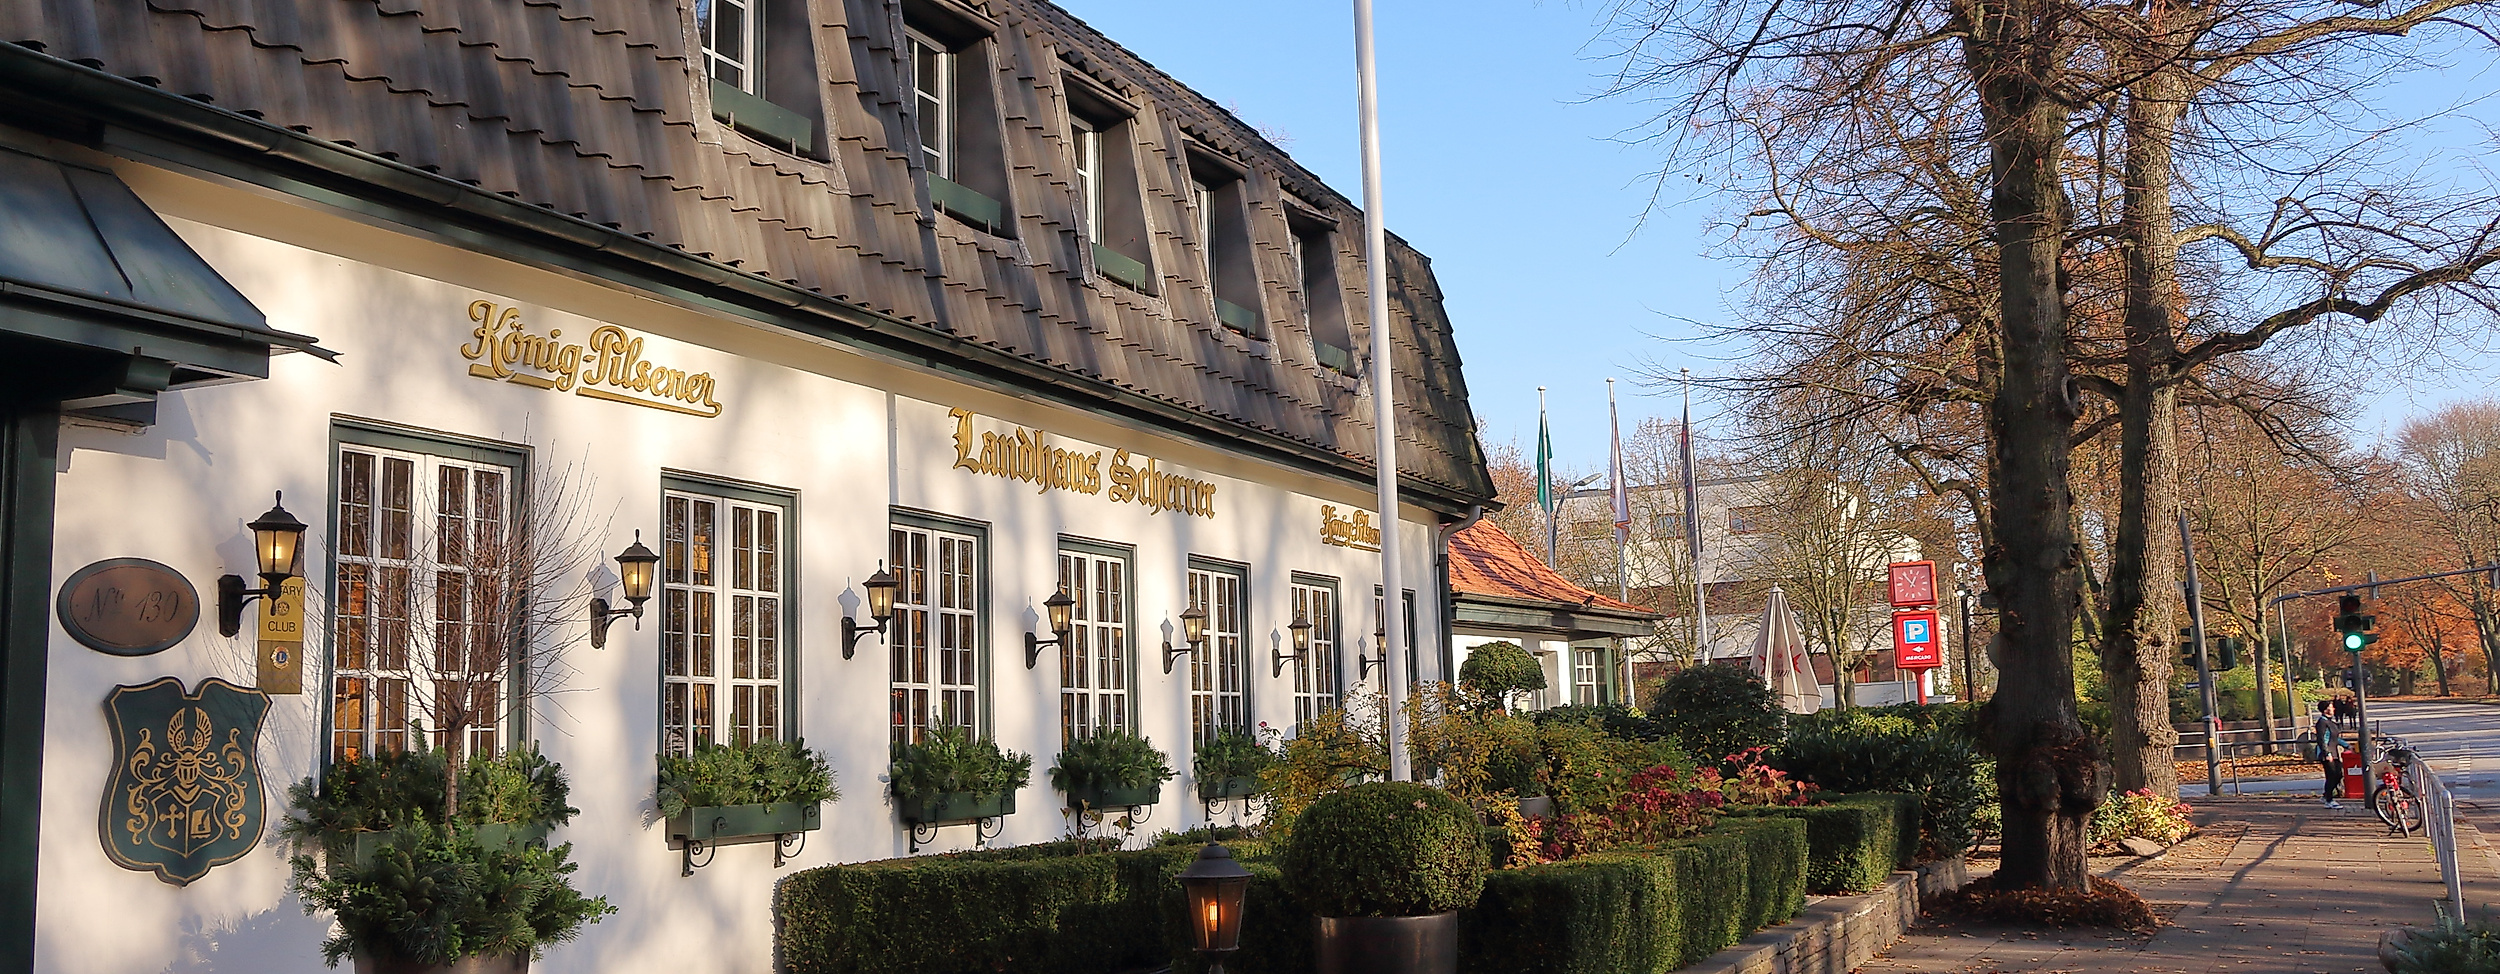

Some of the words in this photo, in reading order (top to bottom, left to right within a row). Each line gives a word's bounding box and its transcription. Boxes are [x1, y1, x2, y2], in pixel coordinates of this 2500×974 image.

[461, 299, 723, 418] König-Pilsener
[948, 407, 1101, 495] Landhaus
[1109, 447, 1217, 519] Scherrer
[135, 590, 179, 623] 130
[268, 620, 296, 632] CLUB
[1909, 623, 1924, 640] P
